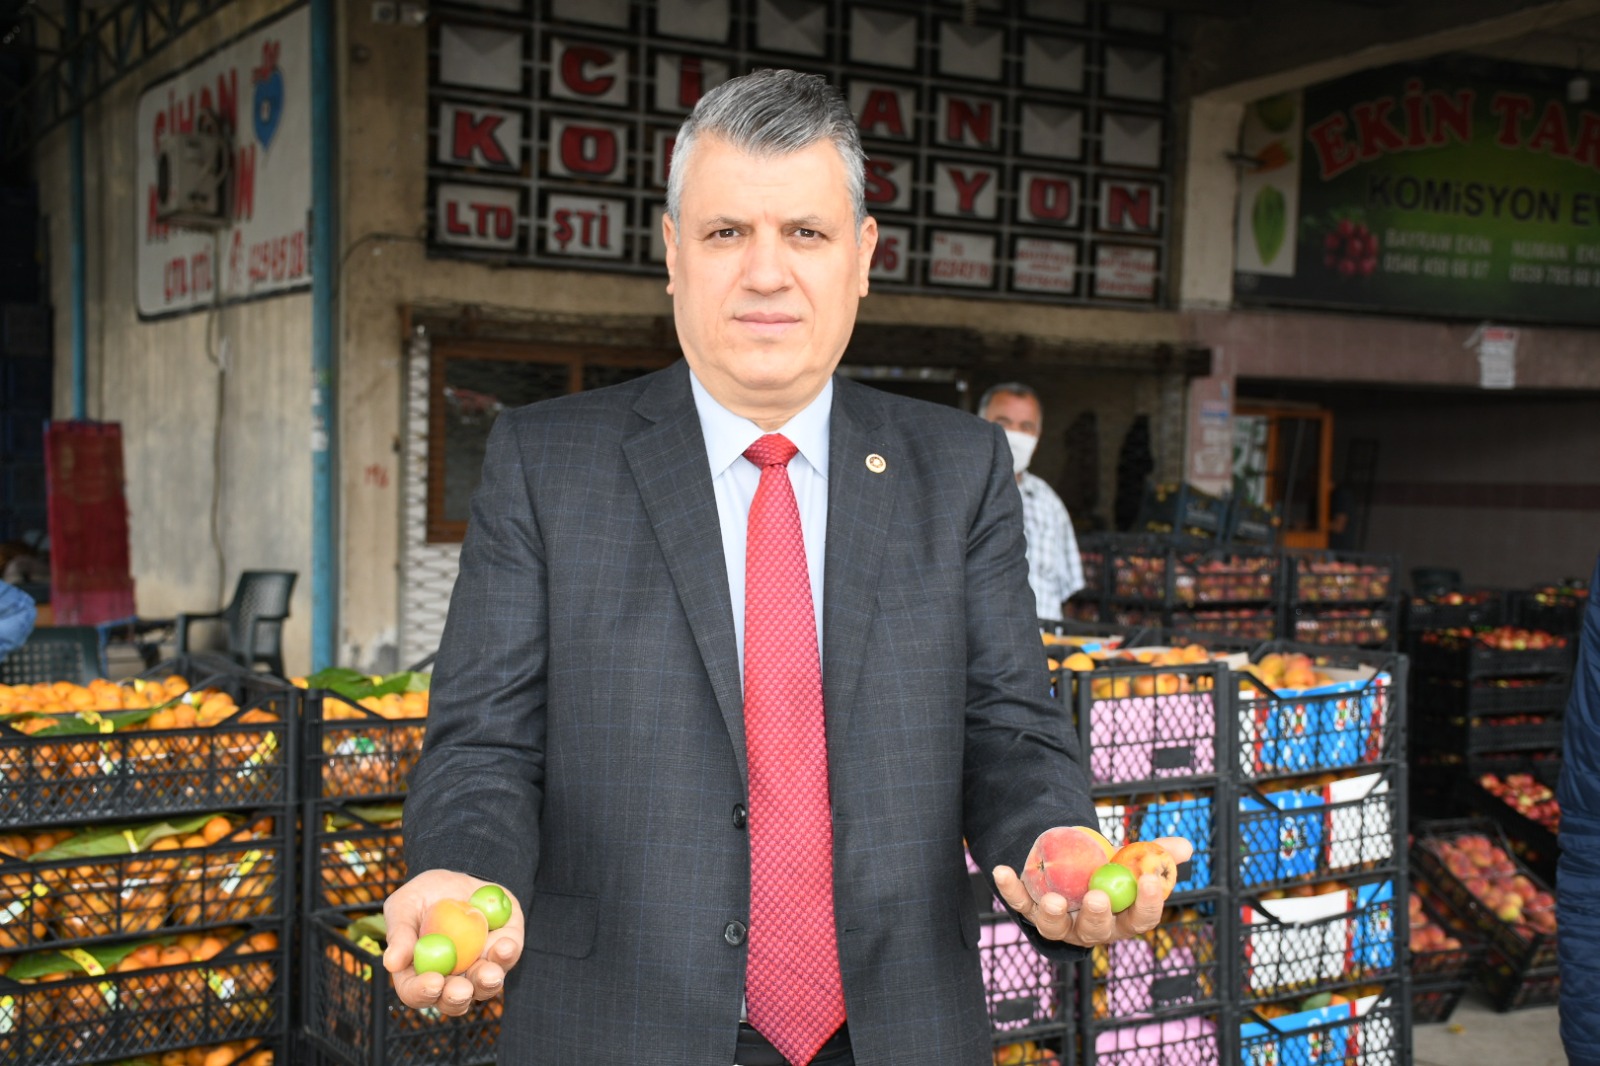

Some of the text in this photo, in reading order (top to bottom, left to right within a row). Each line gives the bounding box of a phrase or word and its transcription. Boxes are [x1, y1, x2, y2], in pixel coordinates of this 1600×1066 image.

[1308, 76, 1475, 181] EKİN
[446, 199, 514, 241] LTD
[553, 203, 613, 254] ŞTİ
